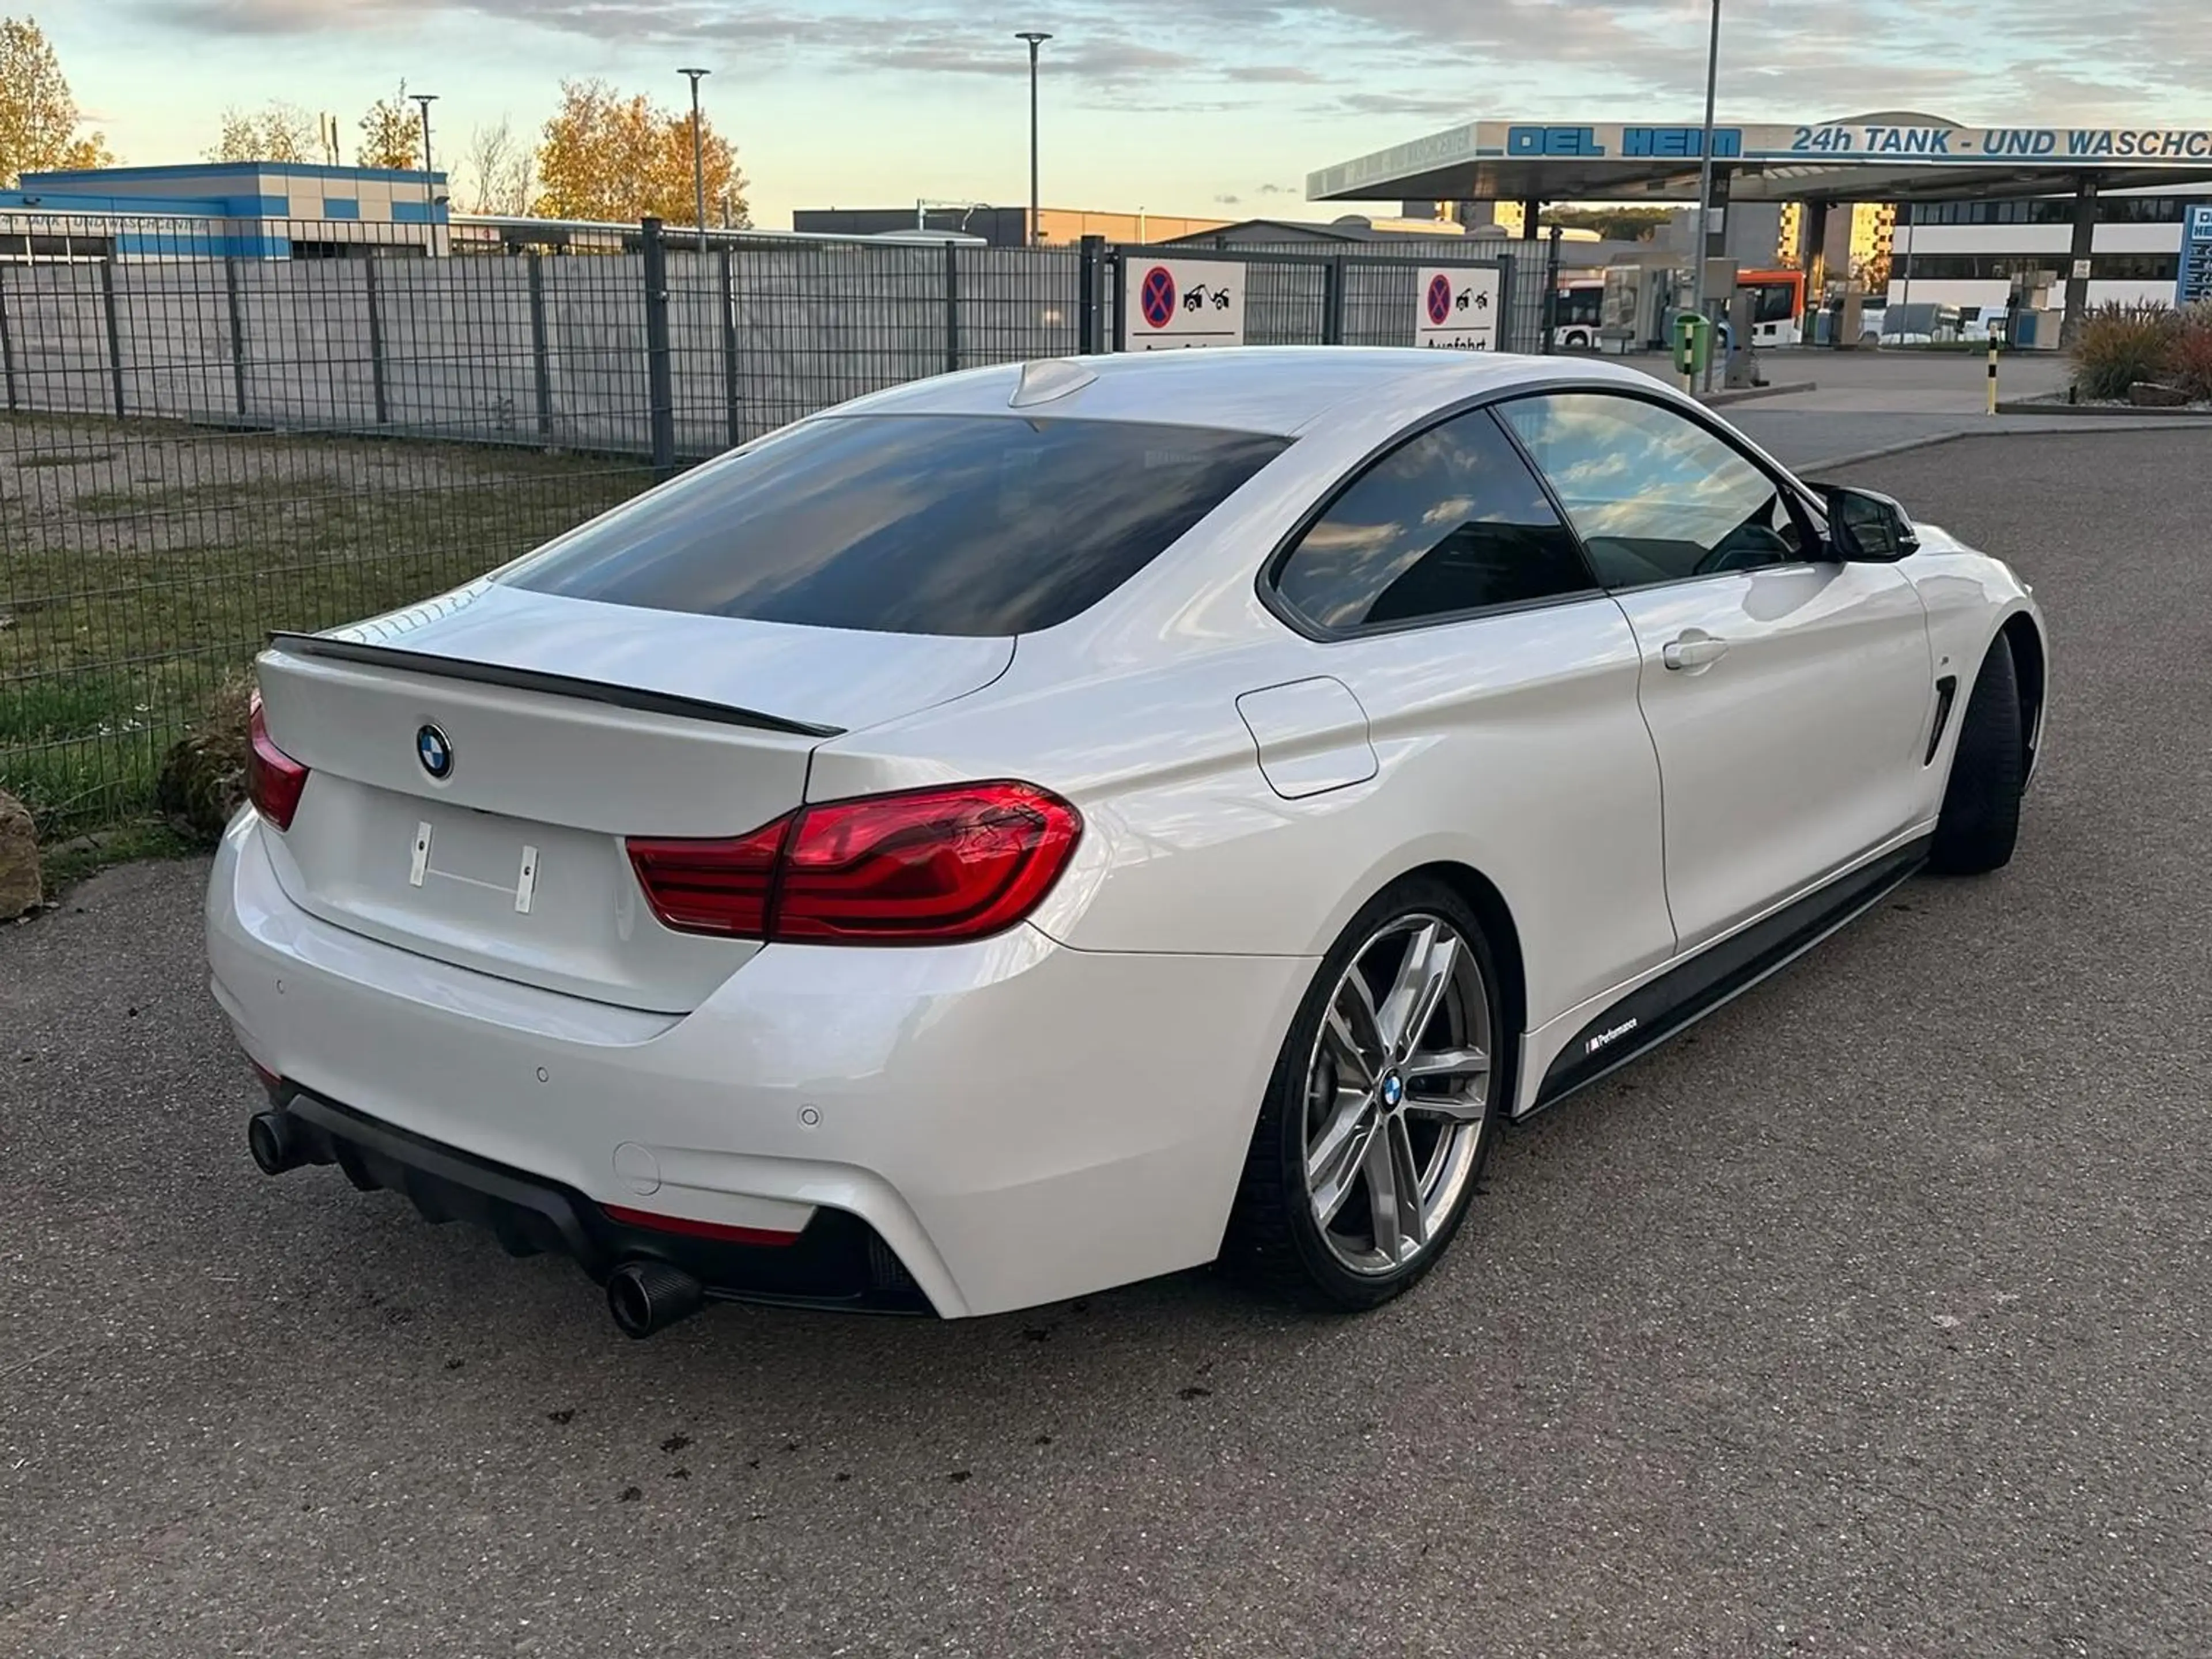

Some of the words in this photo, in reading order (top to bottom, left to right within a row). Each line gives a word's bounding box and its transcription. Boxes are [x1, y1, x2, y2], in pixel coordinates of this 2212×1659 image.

[1508, 127, 1605, 156] OEL
[1623, 128, 1742, 157] HEIM
[1791, 127, 1852, 151] 24h
[1865, 128, 1952, 153] TANK
[1983, 130, 2056, 154] UND
[2067, 131, 2212, 156] WASCHC
